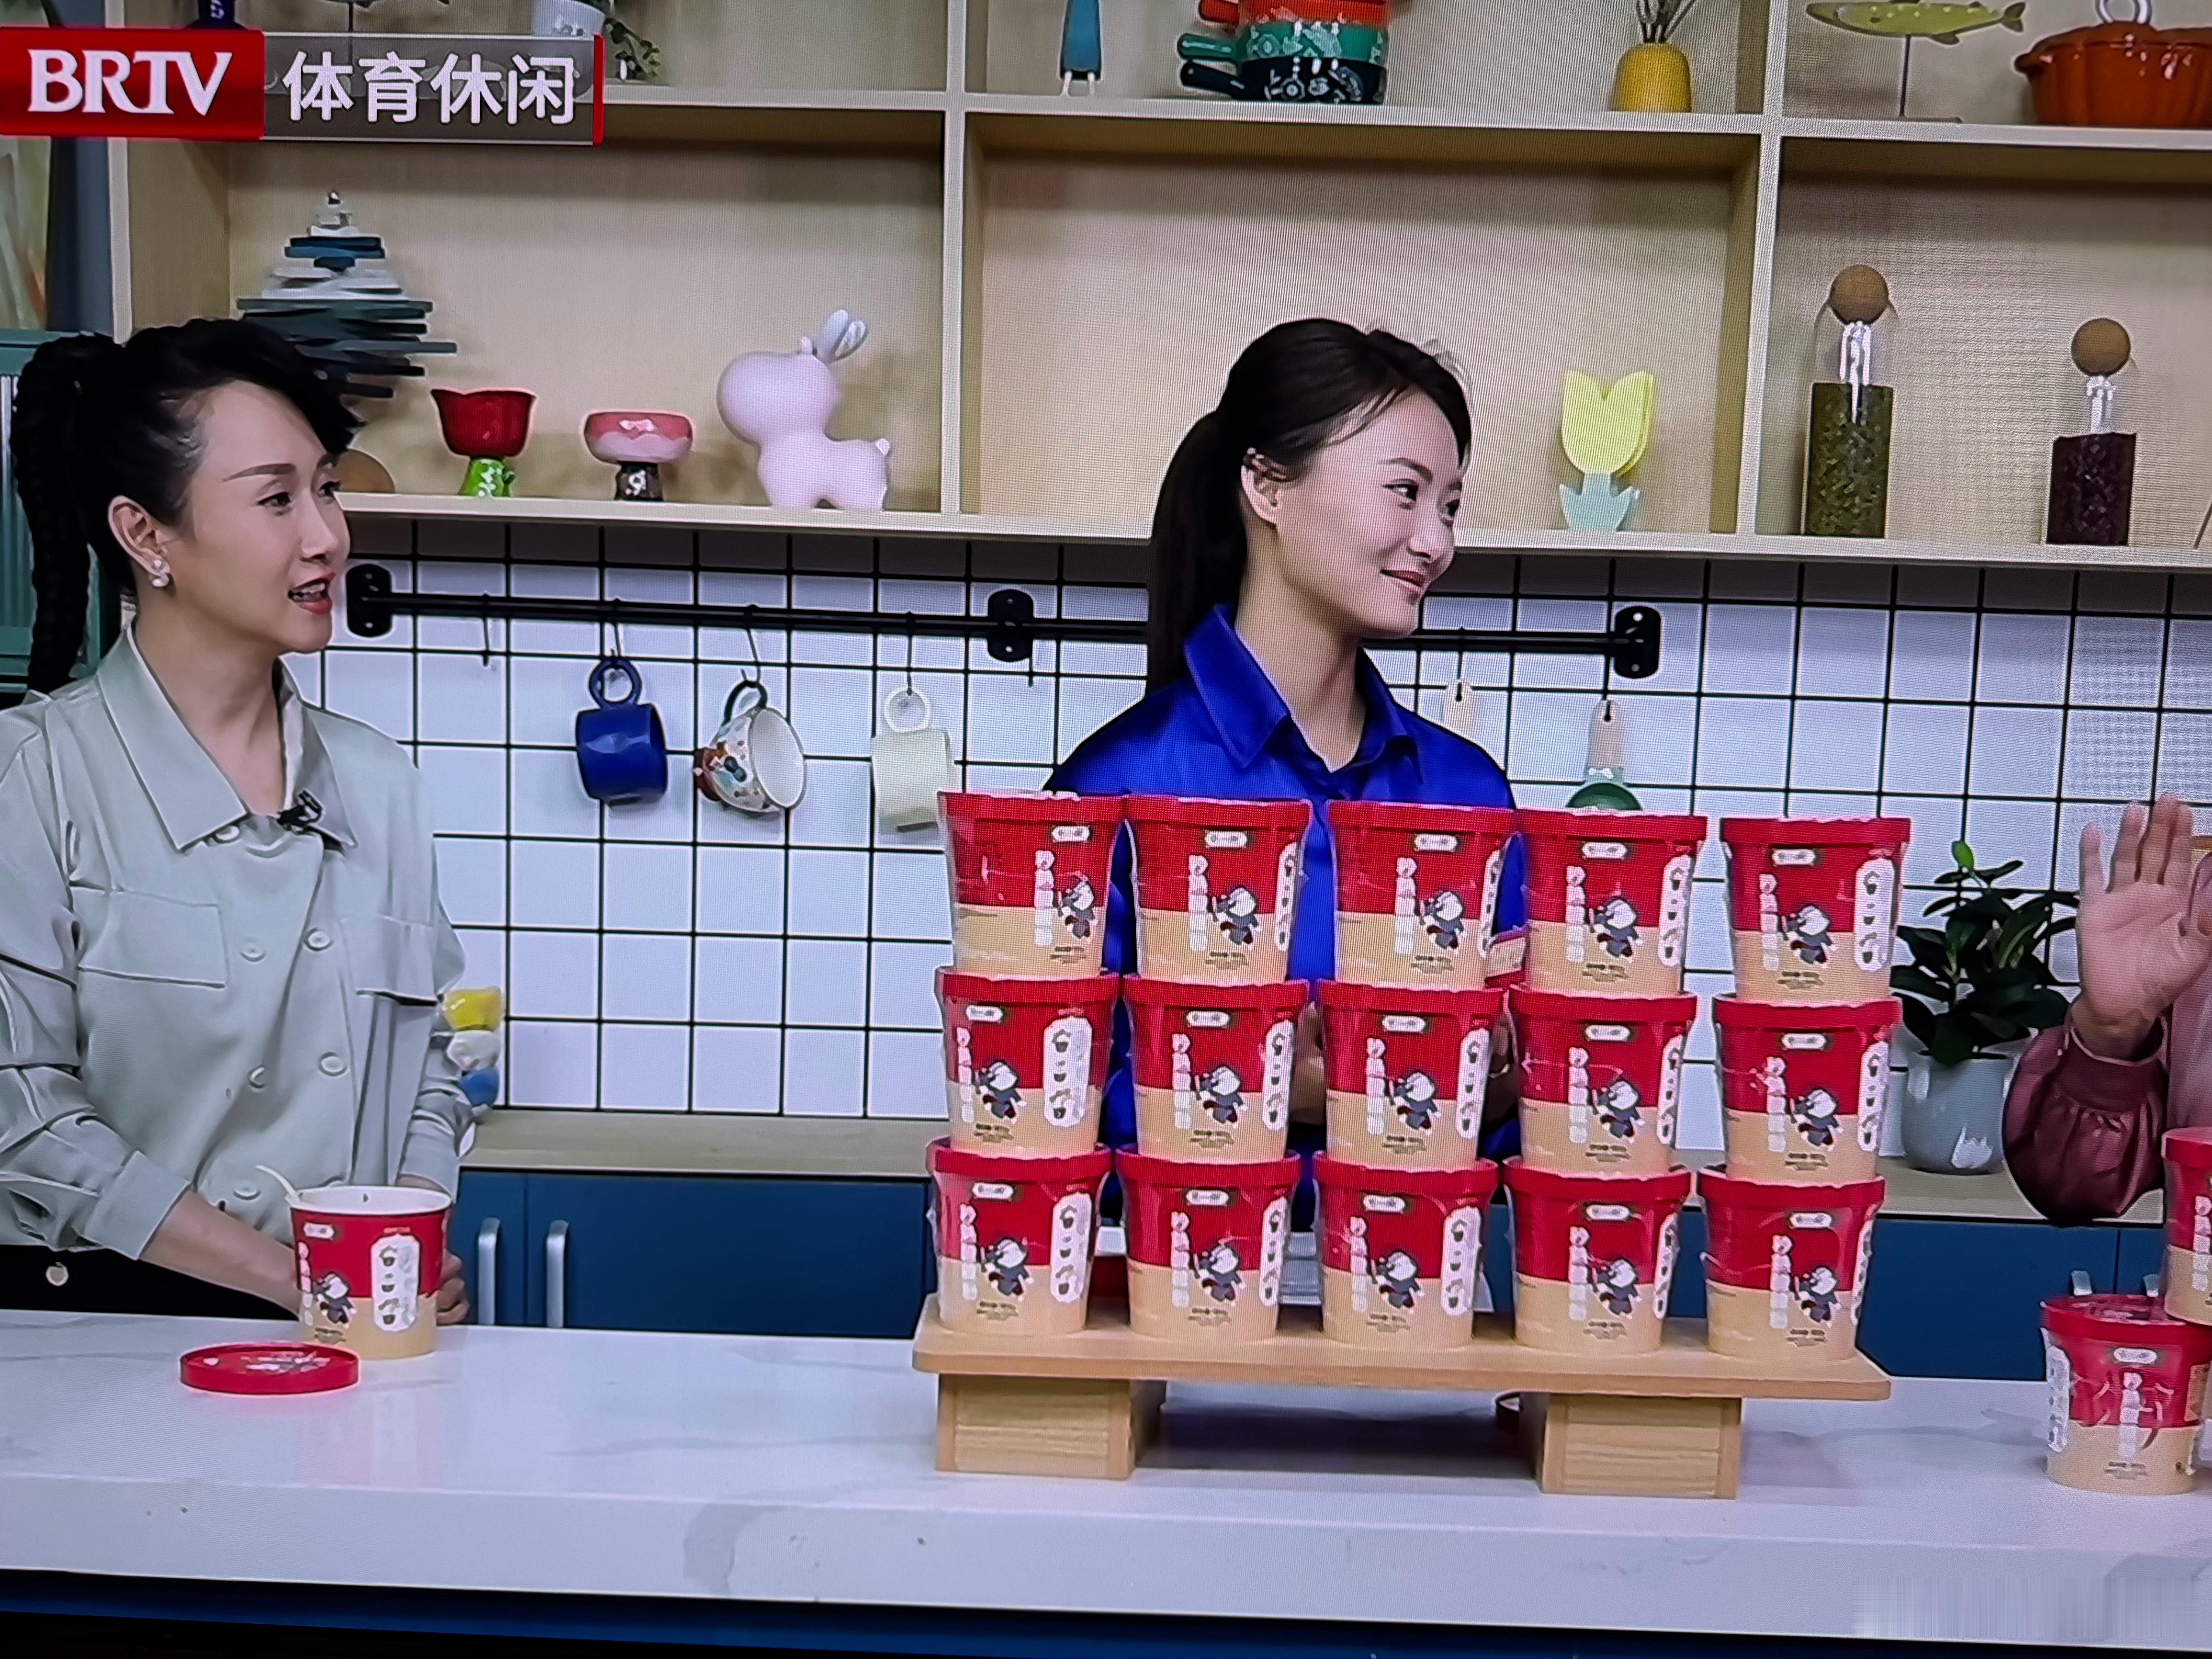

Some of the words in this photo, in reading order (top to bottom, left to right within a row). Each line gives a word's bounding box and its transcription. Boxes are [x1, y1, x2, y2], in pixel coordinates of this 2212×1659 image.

[28, 49, 233, 115] BRTV
[282, 51, 575, 124] 体育休闲
